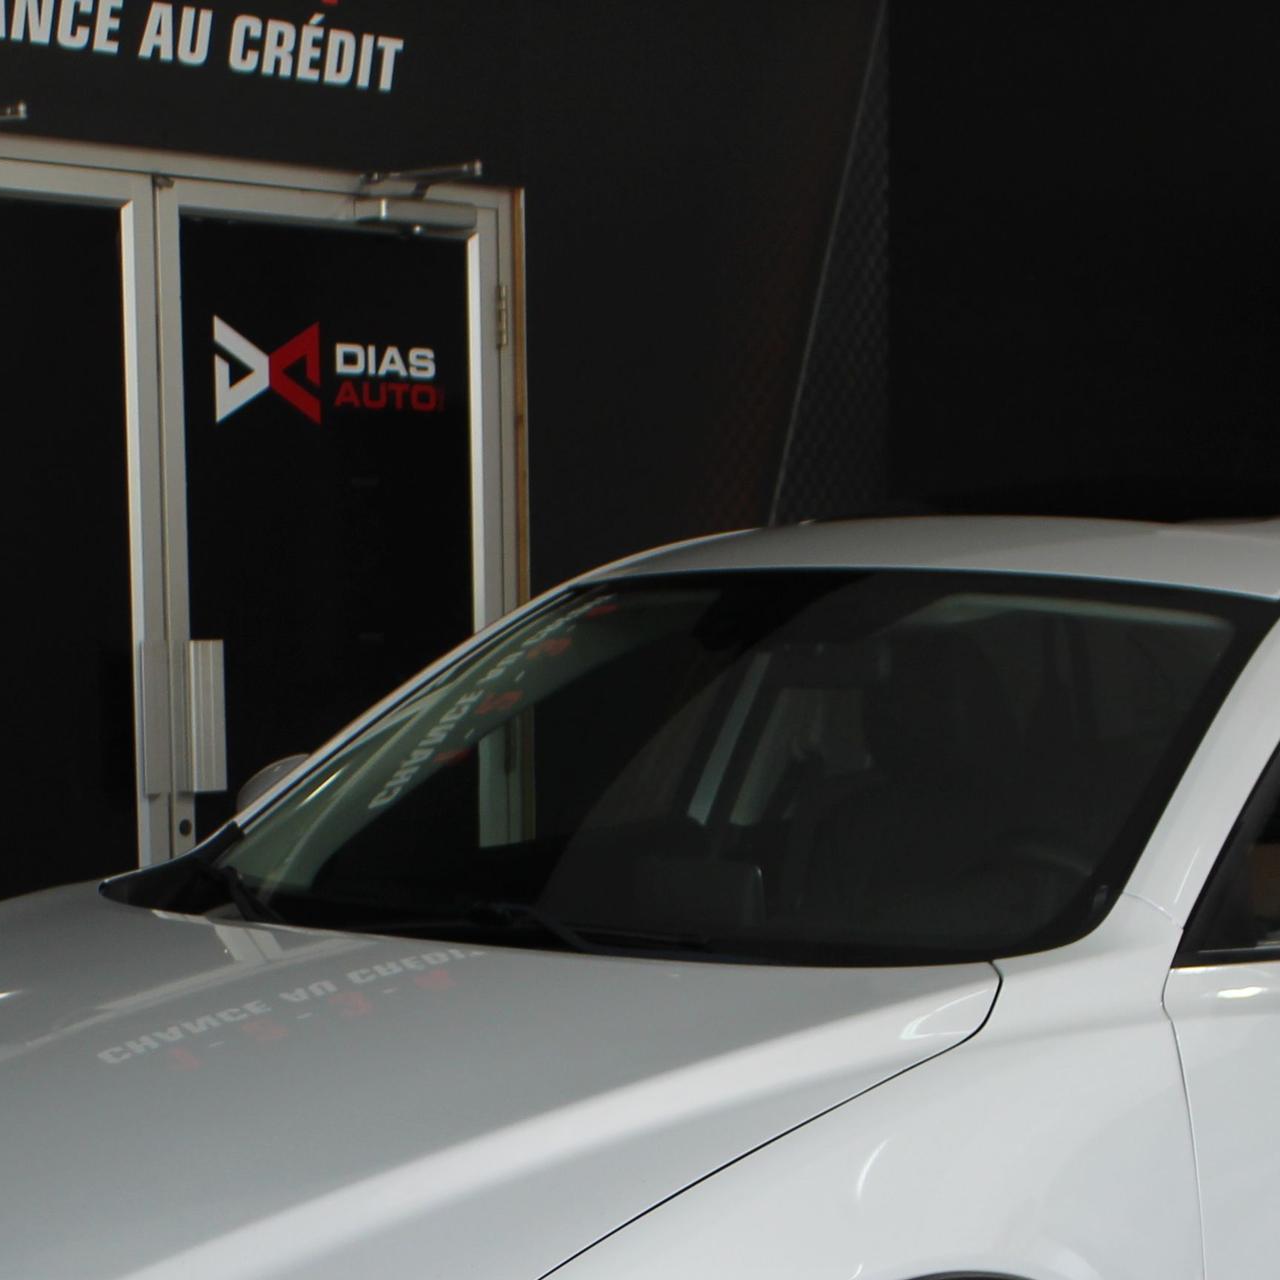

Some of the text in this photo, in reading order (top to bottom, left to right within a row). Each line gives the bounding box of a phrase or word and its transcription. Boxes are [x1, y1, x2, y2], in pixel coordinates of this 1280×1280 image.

[136, 1, 214, 66] AU
[227, 13, 404, 92] CRÉDIT
[334, 342, 437, 379] DIAS
[333, 380, 440, 412] AUTO
